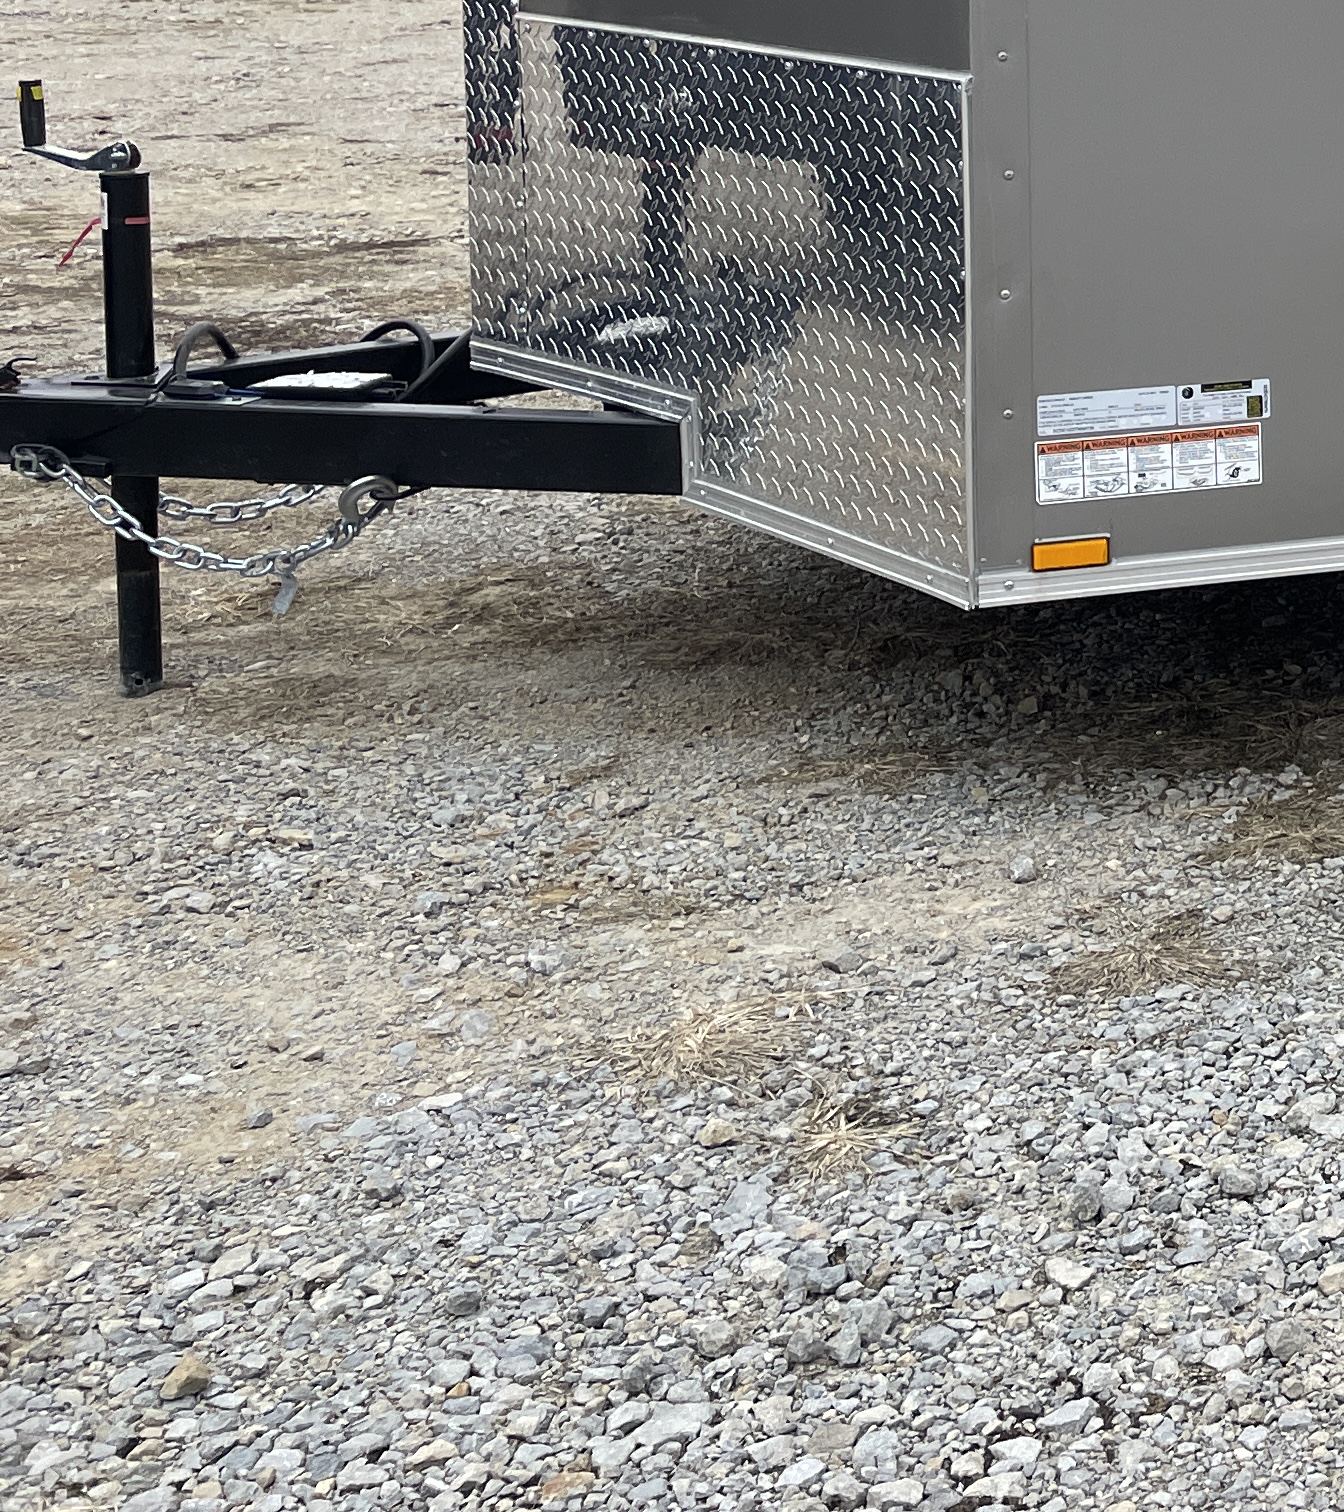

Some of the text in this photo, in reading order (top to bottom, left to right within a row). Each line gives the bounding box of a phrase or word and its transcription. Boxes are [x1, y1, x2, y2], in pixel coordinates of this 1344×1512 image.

[1181, 429, 1215, 440] WARNING
[1223, 425, 1257, 436] WARNING
[1091, 438, 1126, 448] WARNING
[1136, 434, 1170, 444] WARNING
